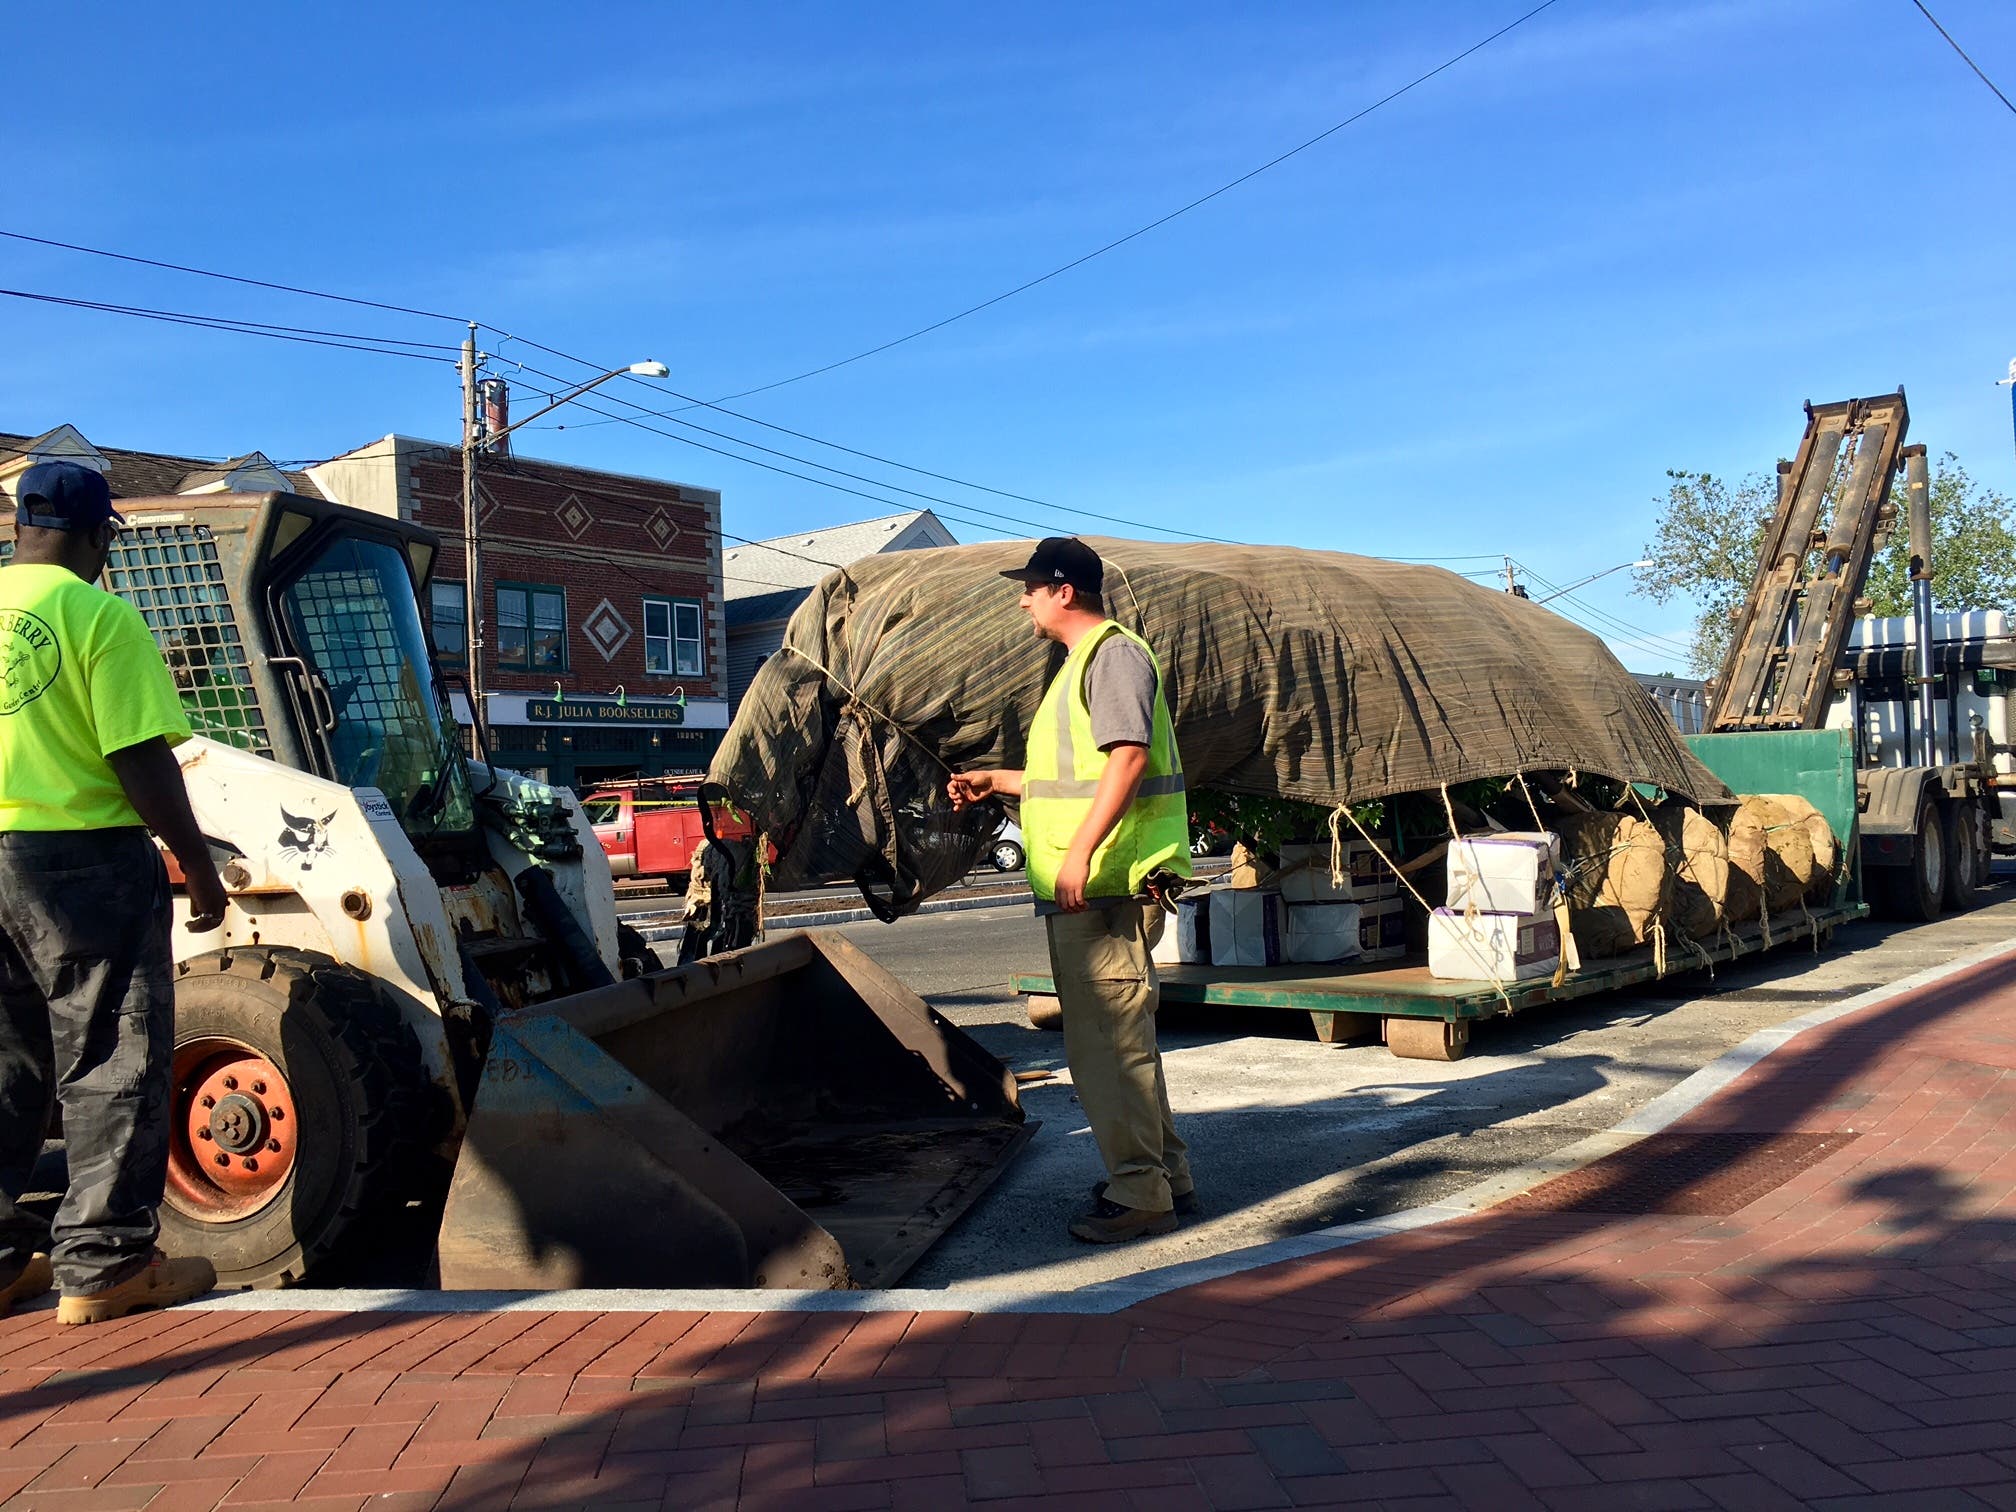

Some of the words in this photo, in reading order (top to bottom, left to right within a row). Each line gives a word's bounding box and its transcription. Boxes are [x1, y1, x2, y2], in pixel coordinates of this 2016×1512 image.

[534, 704, 553, 718] R.J.
[557, 704, 593, 719] JULIA
[599, 706, 679, 720] BOOKSELLERS
